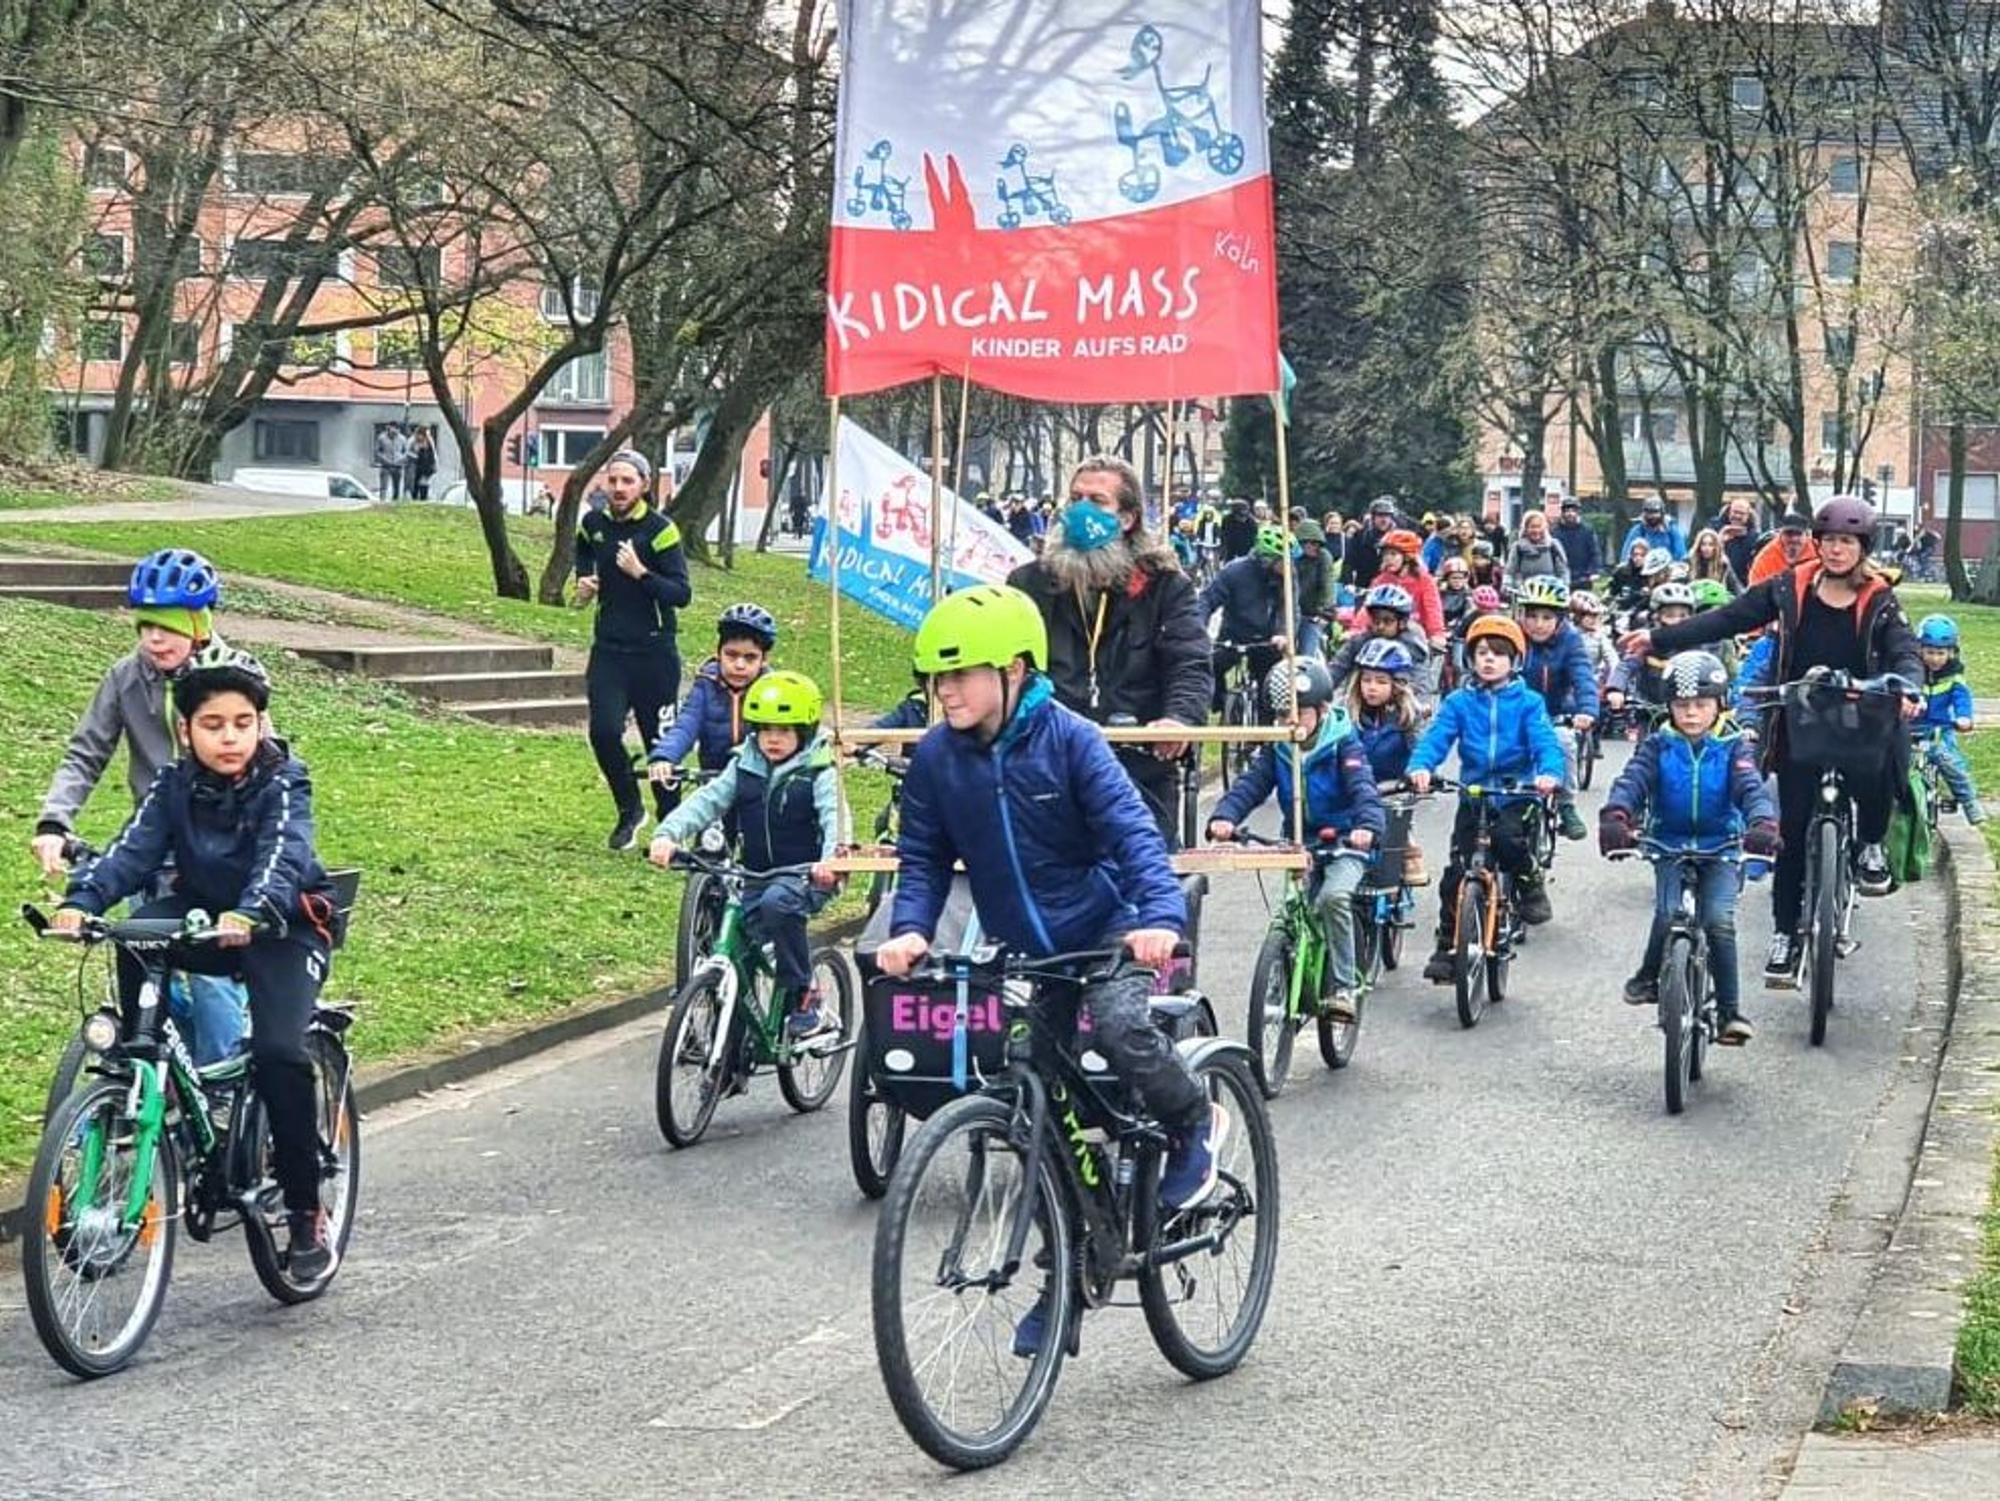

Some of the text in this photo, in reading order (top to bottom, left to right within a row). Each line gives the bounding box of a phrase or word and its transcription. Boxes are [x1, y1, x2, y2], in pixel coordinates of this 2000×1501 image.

[1215, 230, 1259, 272] Köln
[828, 266, 1200, 350] KIDICAL MASS
[971, 338, 1060, 357] KINDER
[892, 995, 1001, 1039] Eigel
